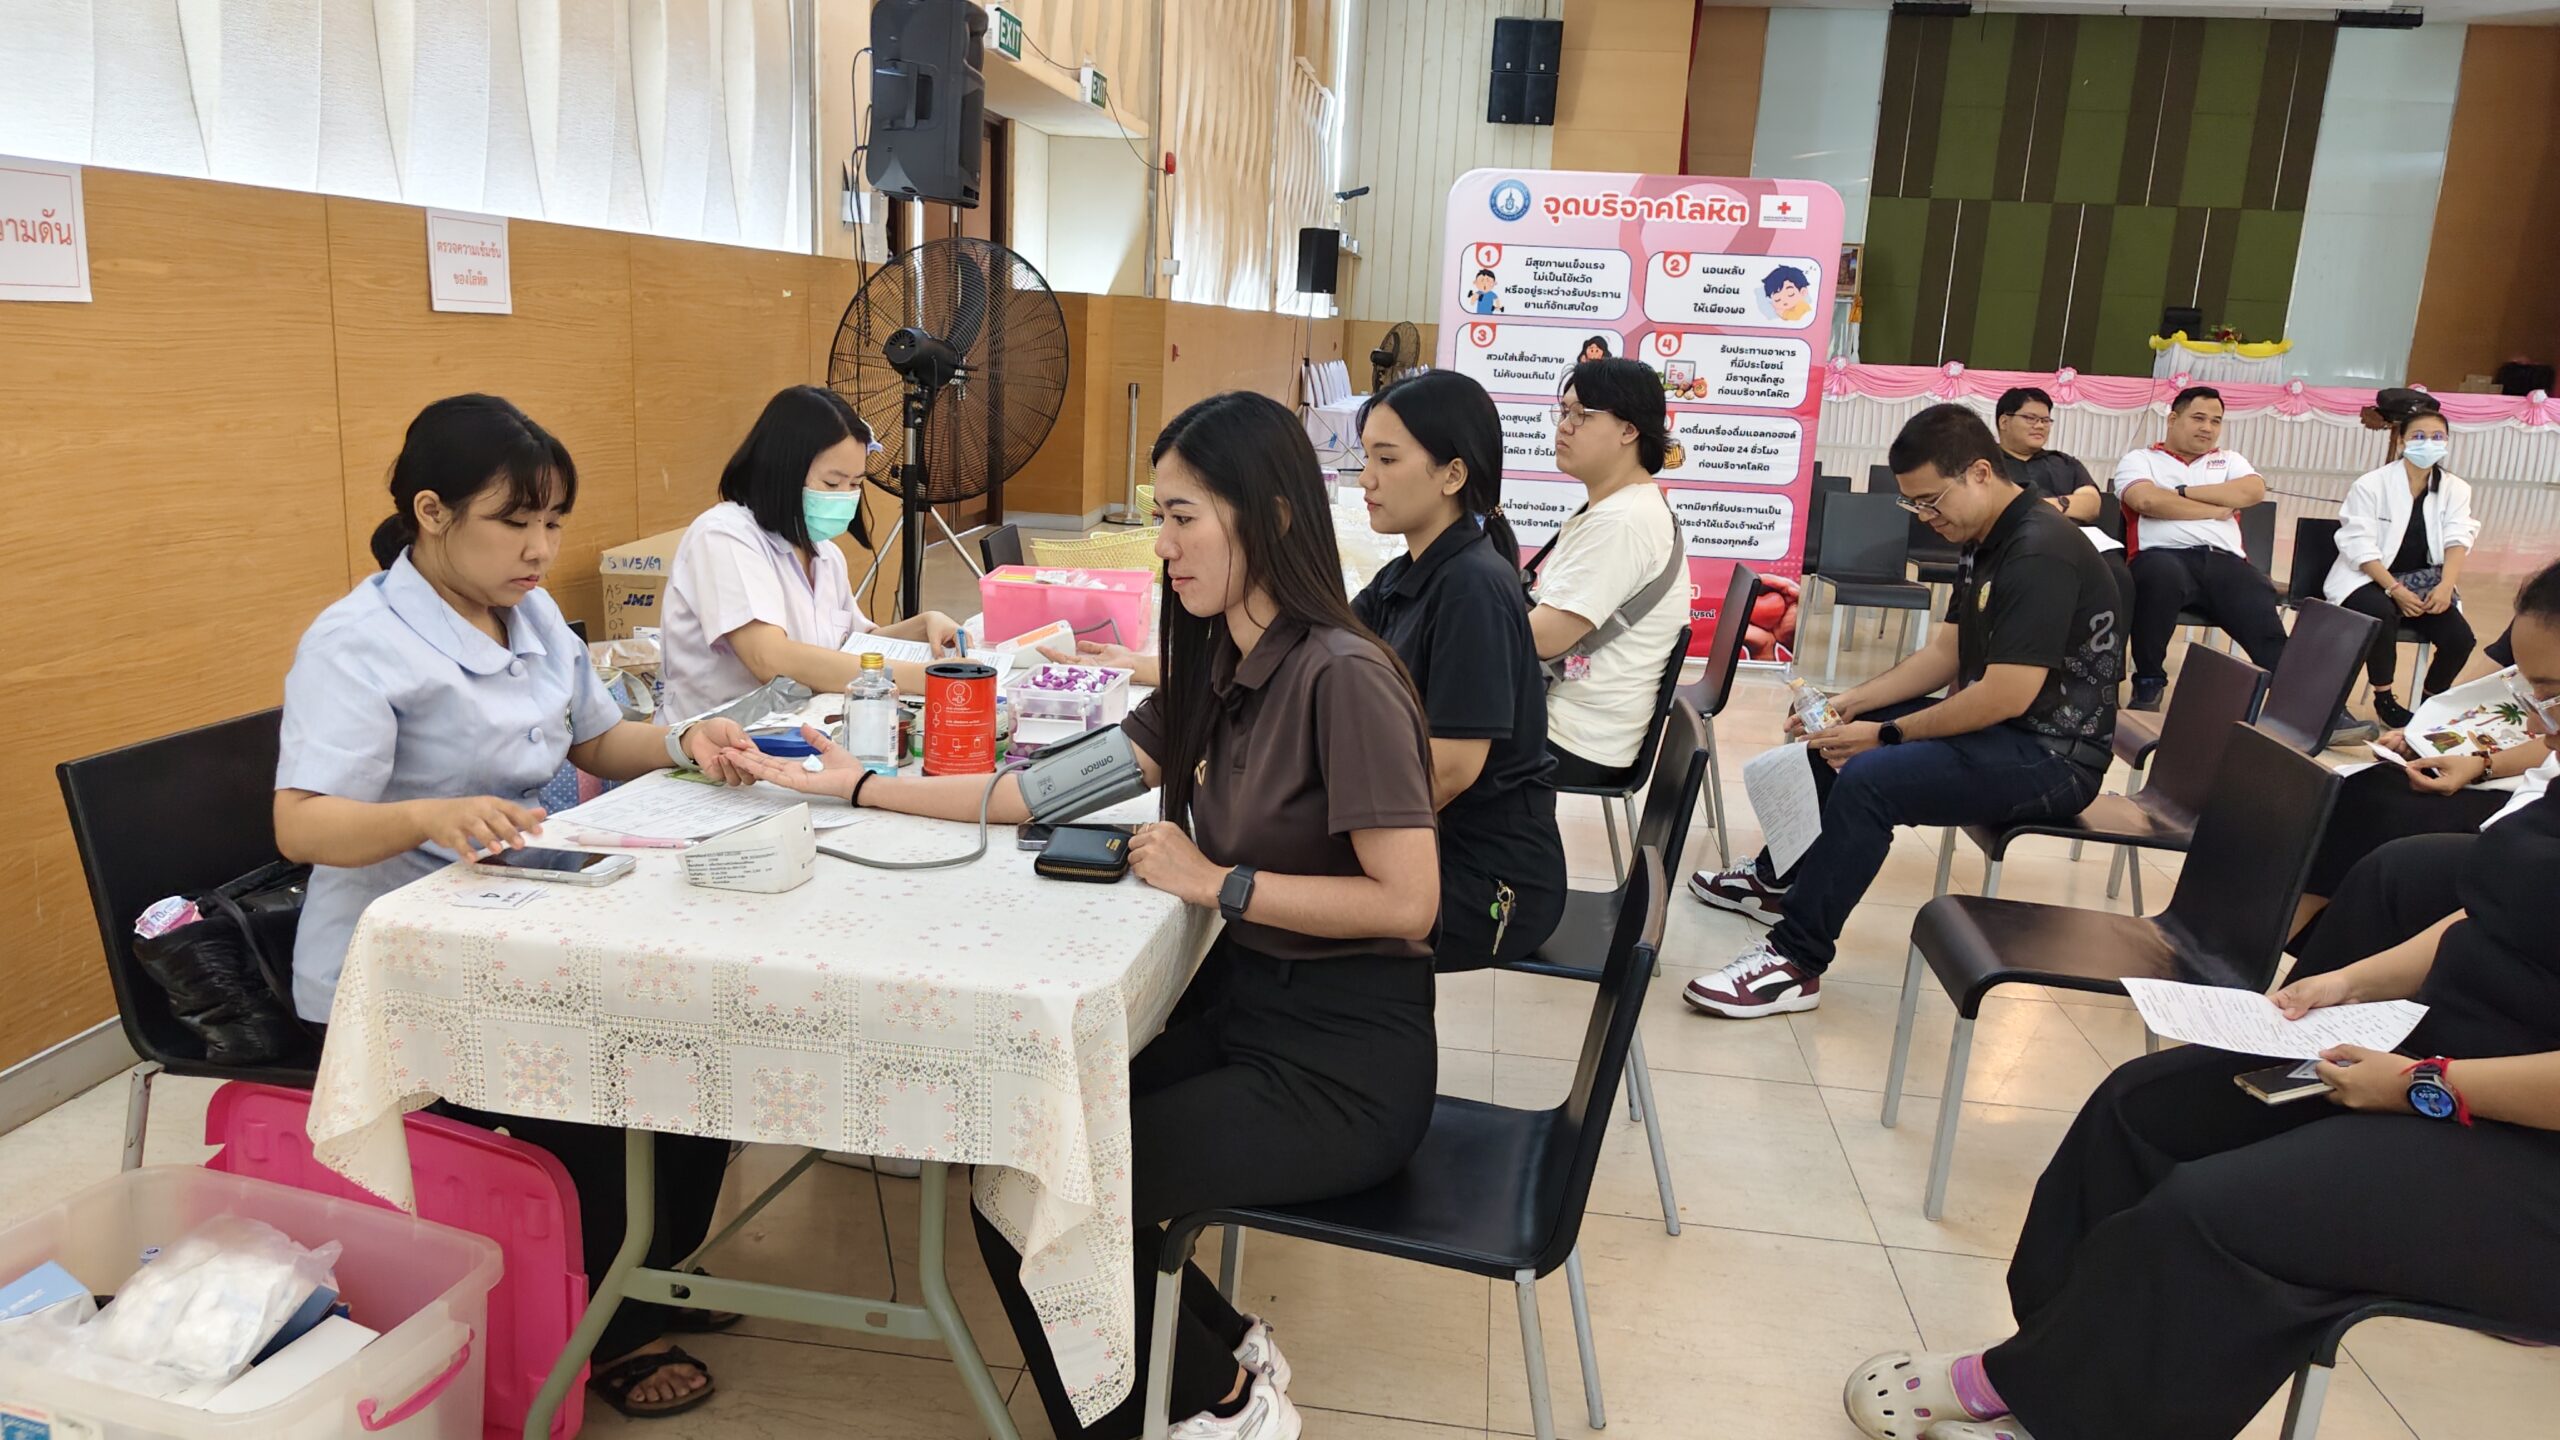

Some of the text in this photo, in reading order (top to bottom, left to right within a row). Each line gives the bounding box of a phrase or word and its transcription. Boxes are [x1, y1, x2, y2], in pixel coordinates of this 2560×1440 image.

[1000, 16, 1021, 52] EXIT
[1543, 193, 1747, 224] จุดบริจาคโลหิต
[1484, 250, 1491, 262] 1
[1525, 257, 1605, 270] มีสุขภาพแข็งแรง
[1670, 260, 1680, 272] 2
[1702, 265, 1746, 276] นอนหลับ
[1533, 271, 1593, 284] ไม่เป็นไข้หวัด
[1504, 284, 1622, 299] หรืออยู่ระหว่างรับประทาน
[1703, 284, 1740, 295] พักผ่อน
[1693, 303, 1746, 315] ให้เพียงพอ
[1477, 330, 1487, 341] 3
[1662, 339, 1672, 351] 4
[1720, 344, 1797, 357] รับประทานอาหาร
[1486, 350, 1565, 364] สวมใส่เสื้อผ้าสบาย
[1730, 357, 1784, 370] ที่มีประโยชน์
[1493, 368, 1555, 381] ไม่คับจนเกินไป
[1669, 369, 1684, 380] Fe
[1725, 372, 1785, 387] มีธาตุเหล็กสูง
[1718, 386, 1790, 399] ก่อนบริจาคโลหิต
[1679, 424, 1798, 439] งดดื่มเครื่องดื่มแอลกอฮอล์
[1693, 443, 1779, 455] อย่างน้อย 24 ชั่วโมง
[1699, 461, 1771, 472] ก่อนบริจาคโลหิต
[1676, 502, 1782, 515] หากมียาที่รับประทานเป็น
[1679, 518, 1775, 531] ประจำให้แจ้งเจ้าหน้าที่
[1691, 534, 1760, 548] คัดกรองทุกครั้ง
[623, 593, 655, 607] JMS
